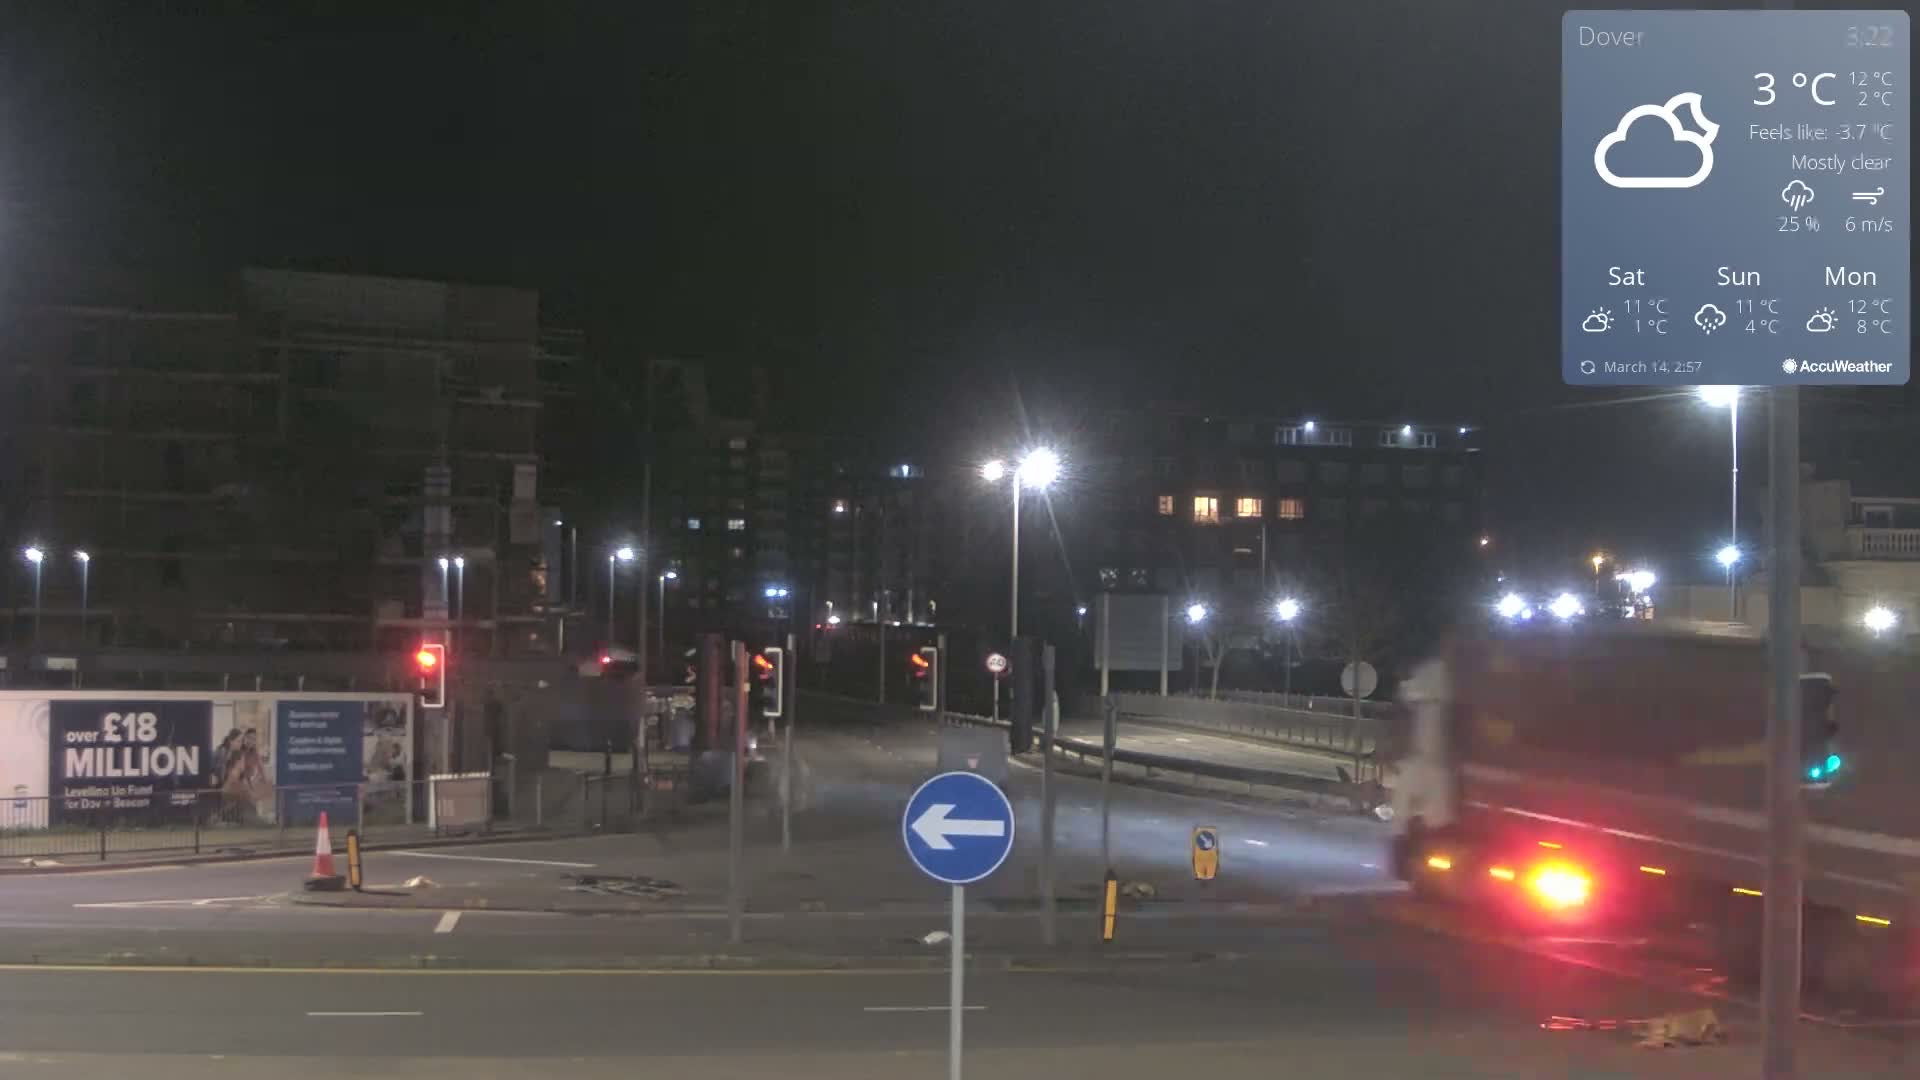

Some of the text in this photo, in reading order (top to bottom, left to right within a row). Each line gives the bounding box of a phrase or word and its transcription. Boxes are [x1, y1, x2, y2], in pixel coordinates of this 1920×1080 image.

[65, 711, 158, 743] over £18
[65, 746, 200, 778] MILLION
[128, 785, 153, 796] Fund
